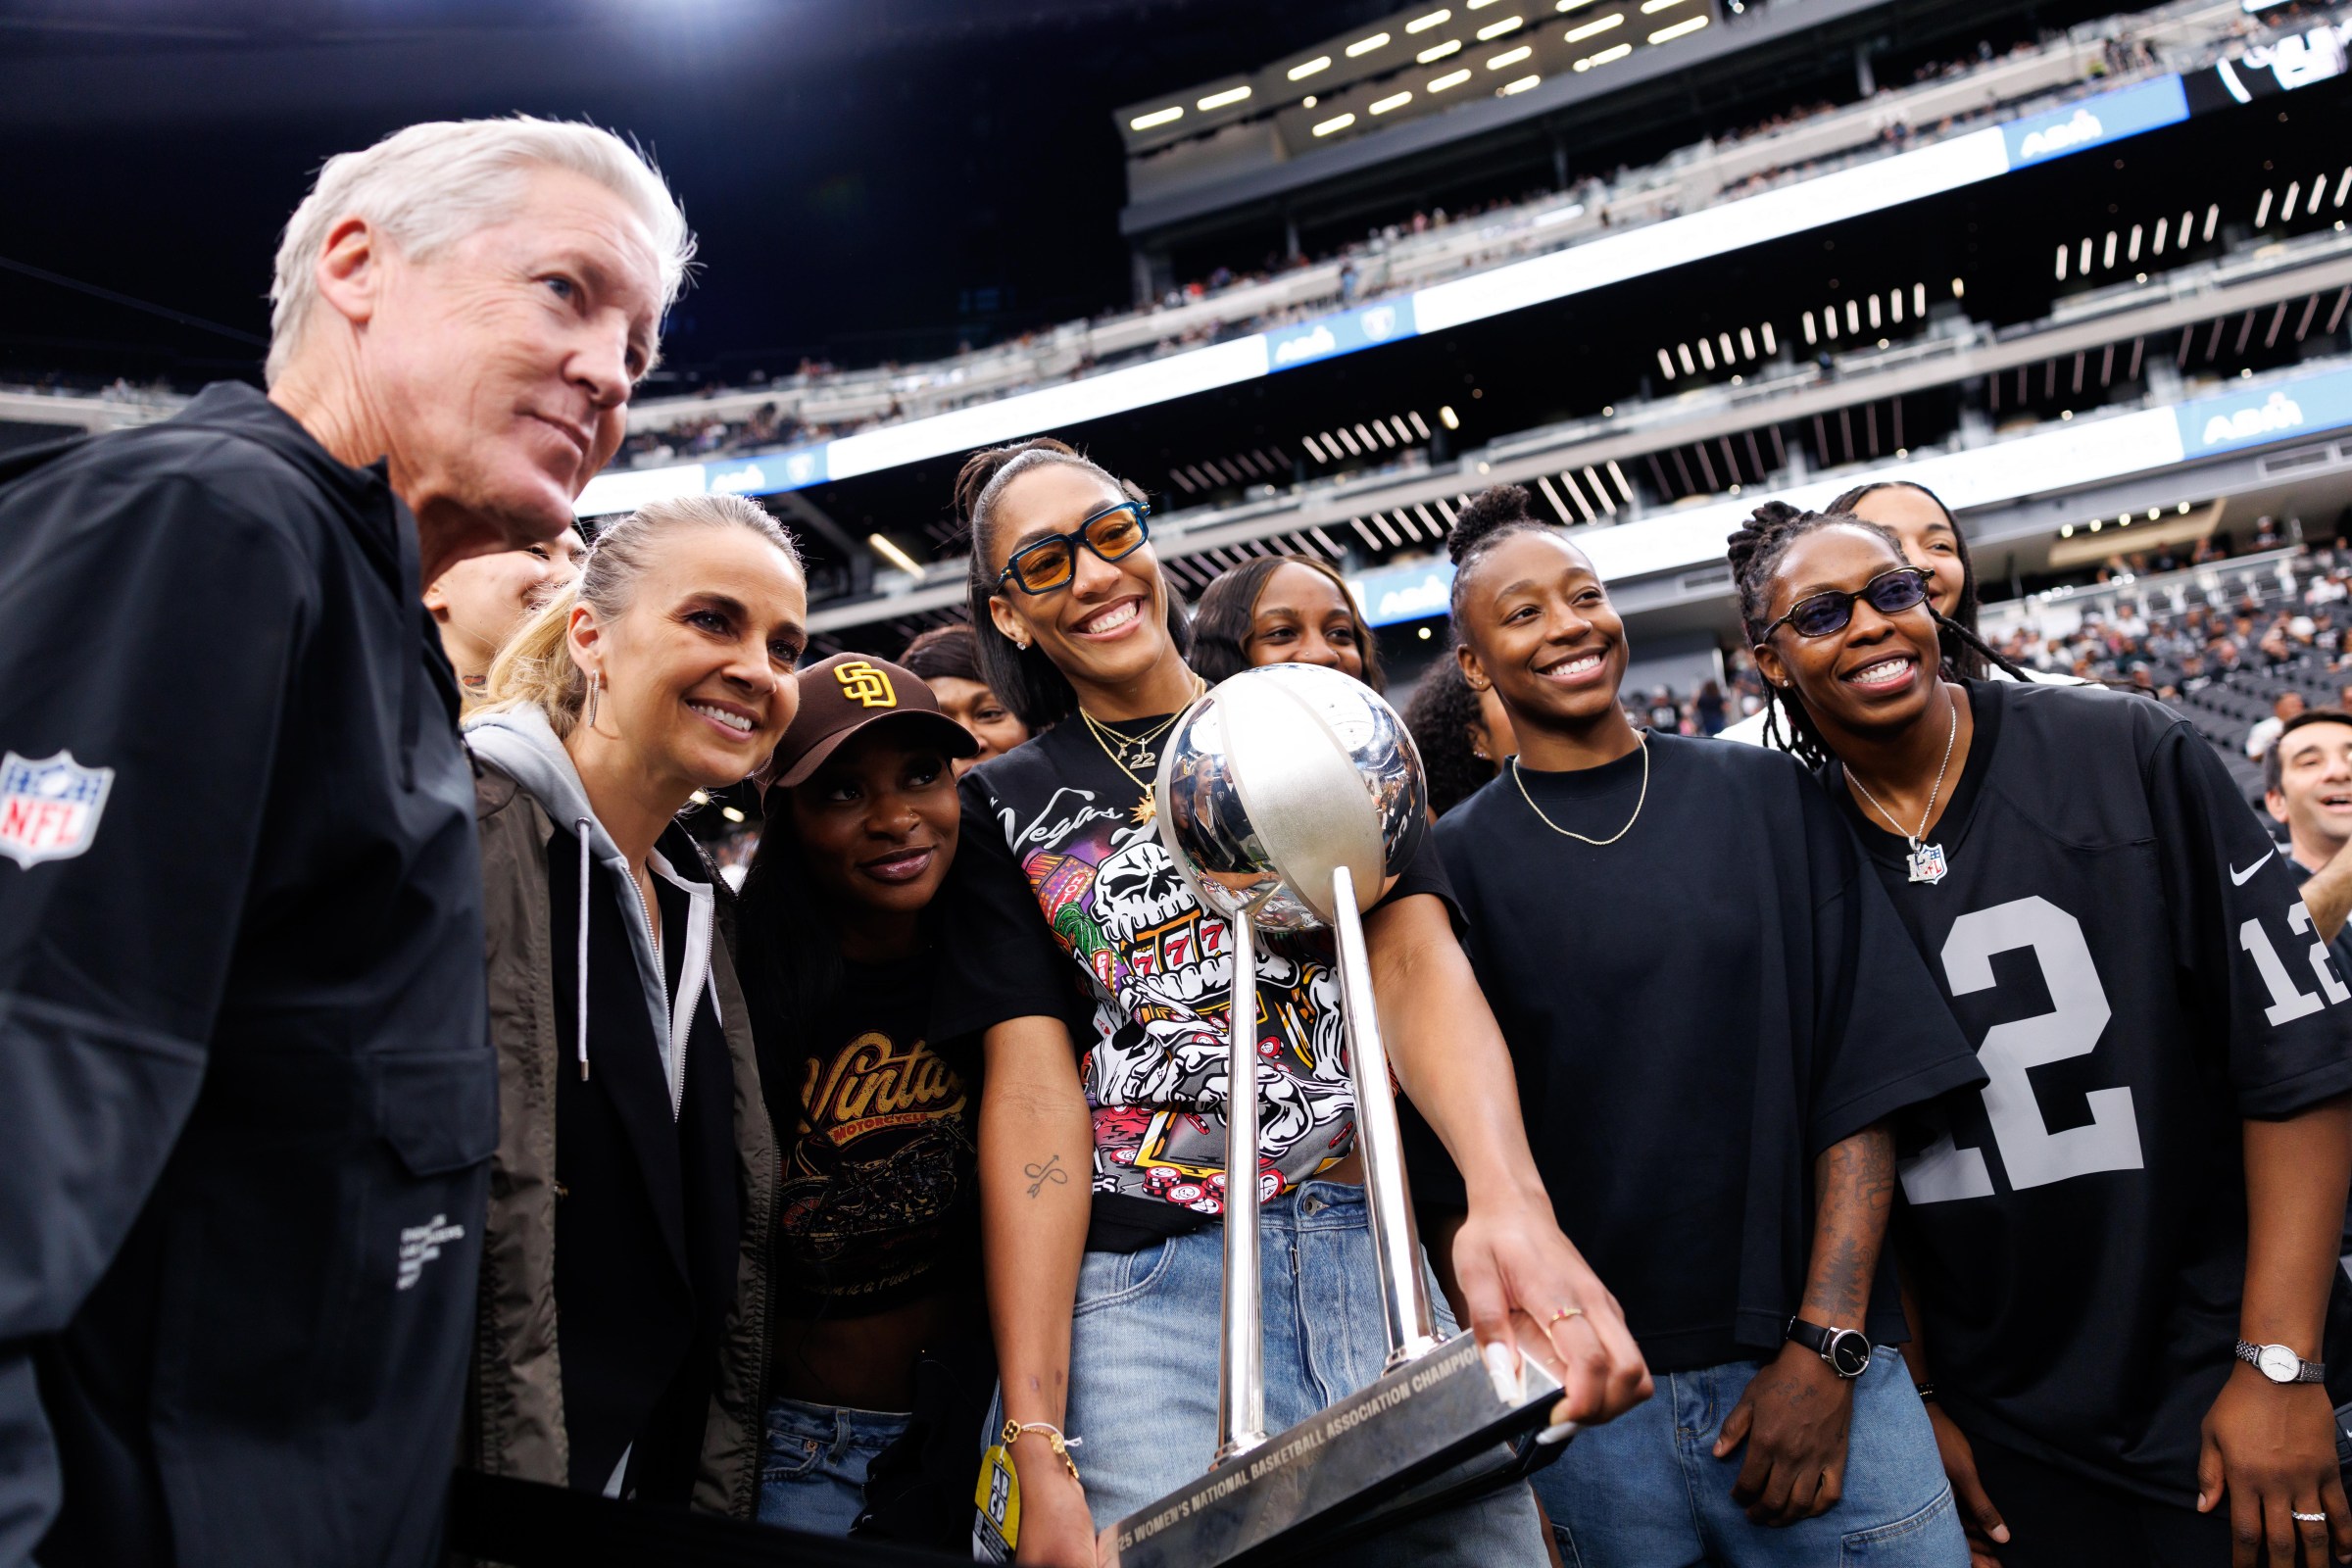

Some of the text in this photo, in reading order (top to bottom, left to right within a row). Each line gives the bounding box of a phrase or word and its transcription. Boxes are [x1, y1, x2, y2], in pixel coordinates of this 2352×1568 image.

[834, 662, 897, 708] SD
[1129, 752, 1156, 770] 22
[1, 797, 78, 847] NFL
[997, 787, 1124, 857] Vegas
[1906, 853, 1935, 882] 12
[1165, 935, 1189, 966] 7
[1200, 923, 1223, 952] 7
[2239, 901, 2352, 1027] 12
[1897, 895, 2144, 1205] 2
[797, 1031, 965, 1134] Vinta
[833, 1112, 928, 1142] MOTORCYCLE
[1134, 1500, 1191, 1544] WOMEN'S
[1191, 1469, 1250, 1512] NATIONAL
[1250, 1429, 1326, 1481] BASKETBALL
[1326, 1381, 1411, 1438] ASSOCIATION
